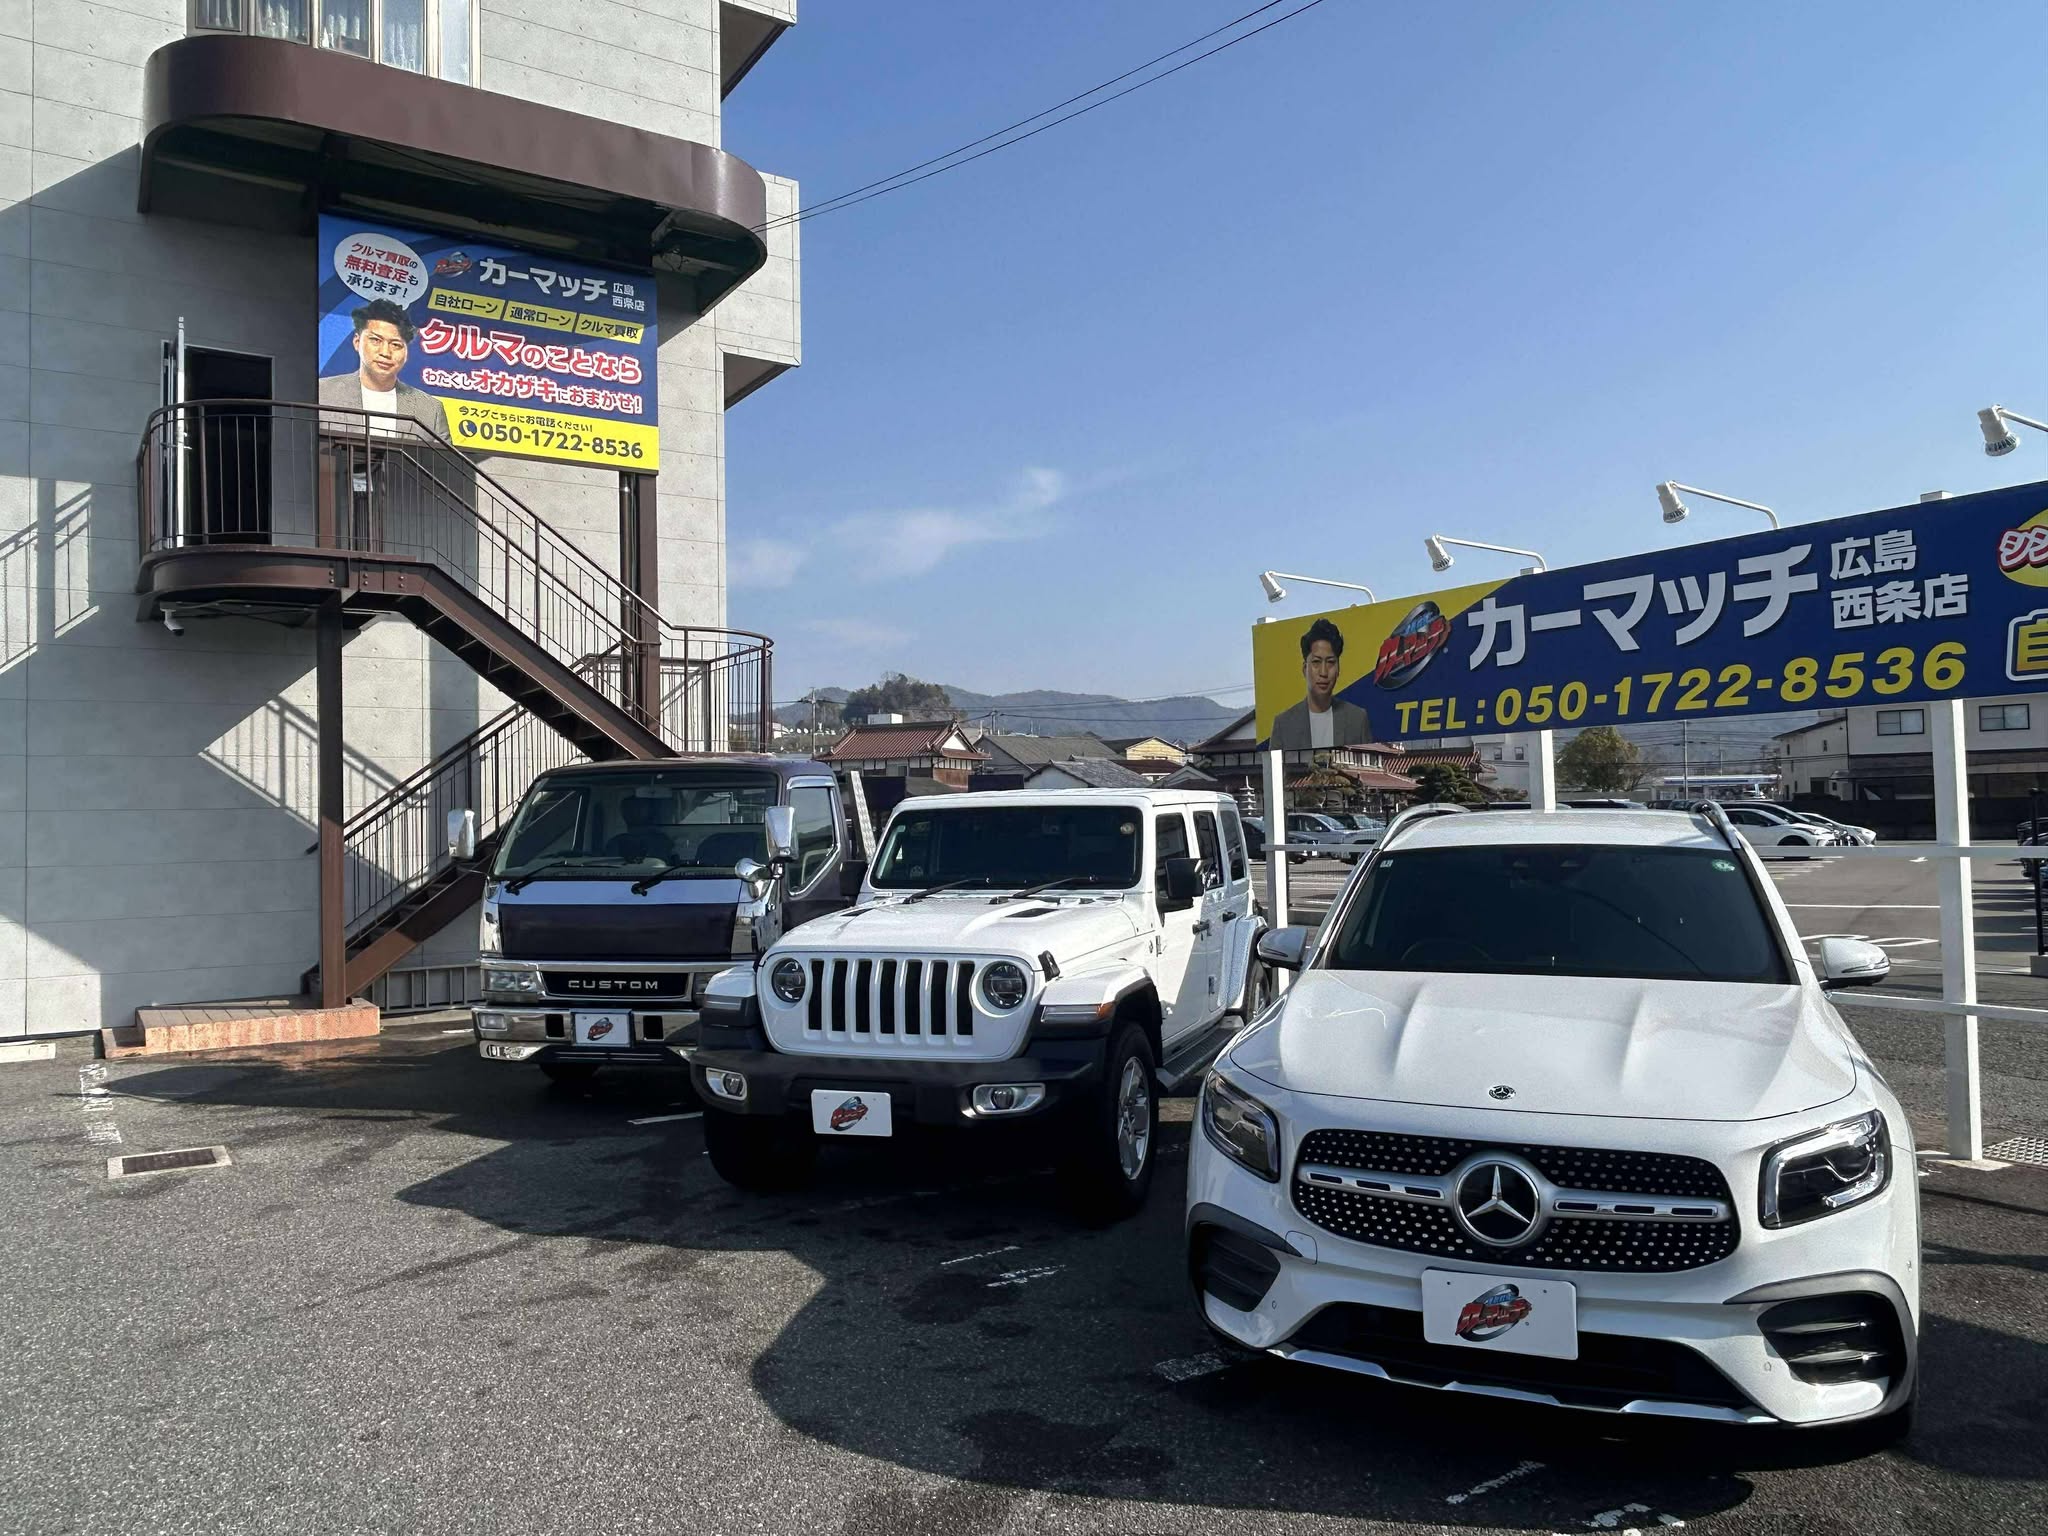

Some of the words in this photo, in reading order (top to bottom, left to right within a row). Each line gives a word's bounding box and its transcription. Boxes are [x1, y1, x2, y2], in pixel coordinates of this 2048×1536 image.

[344, 254, 419, 286] 無料査定も
[479, 257, 608, 301] カーマッチ
[434, 293, 498, 315] 自社ローン
[612, 282, 635, 297] 広島
[509, 306, 571, 327] 通常ローン
[580, 319, 639, 339] クルマ買取
[420, 319, 642, 384] クルマのことなら
[479, 422, 644, 459] 050-1722-8536
[1829, 529, 1917, 580] 広島
[1467, 543, 1818, 671] カーマッチ
[1831, 573, 1969, 630] 西条店
[567, 980, 659, 990] CUSTOM
